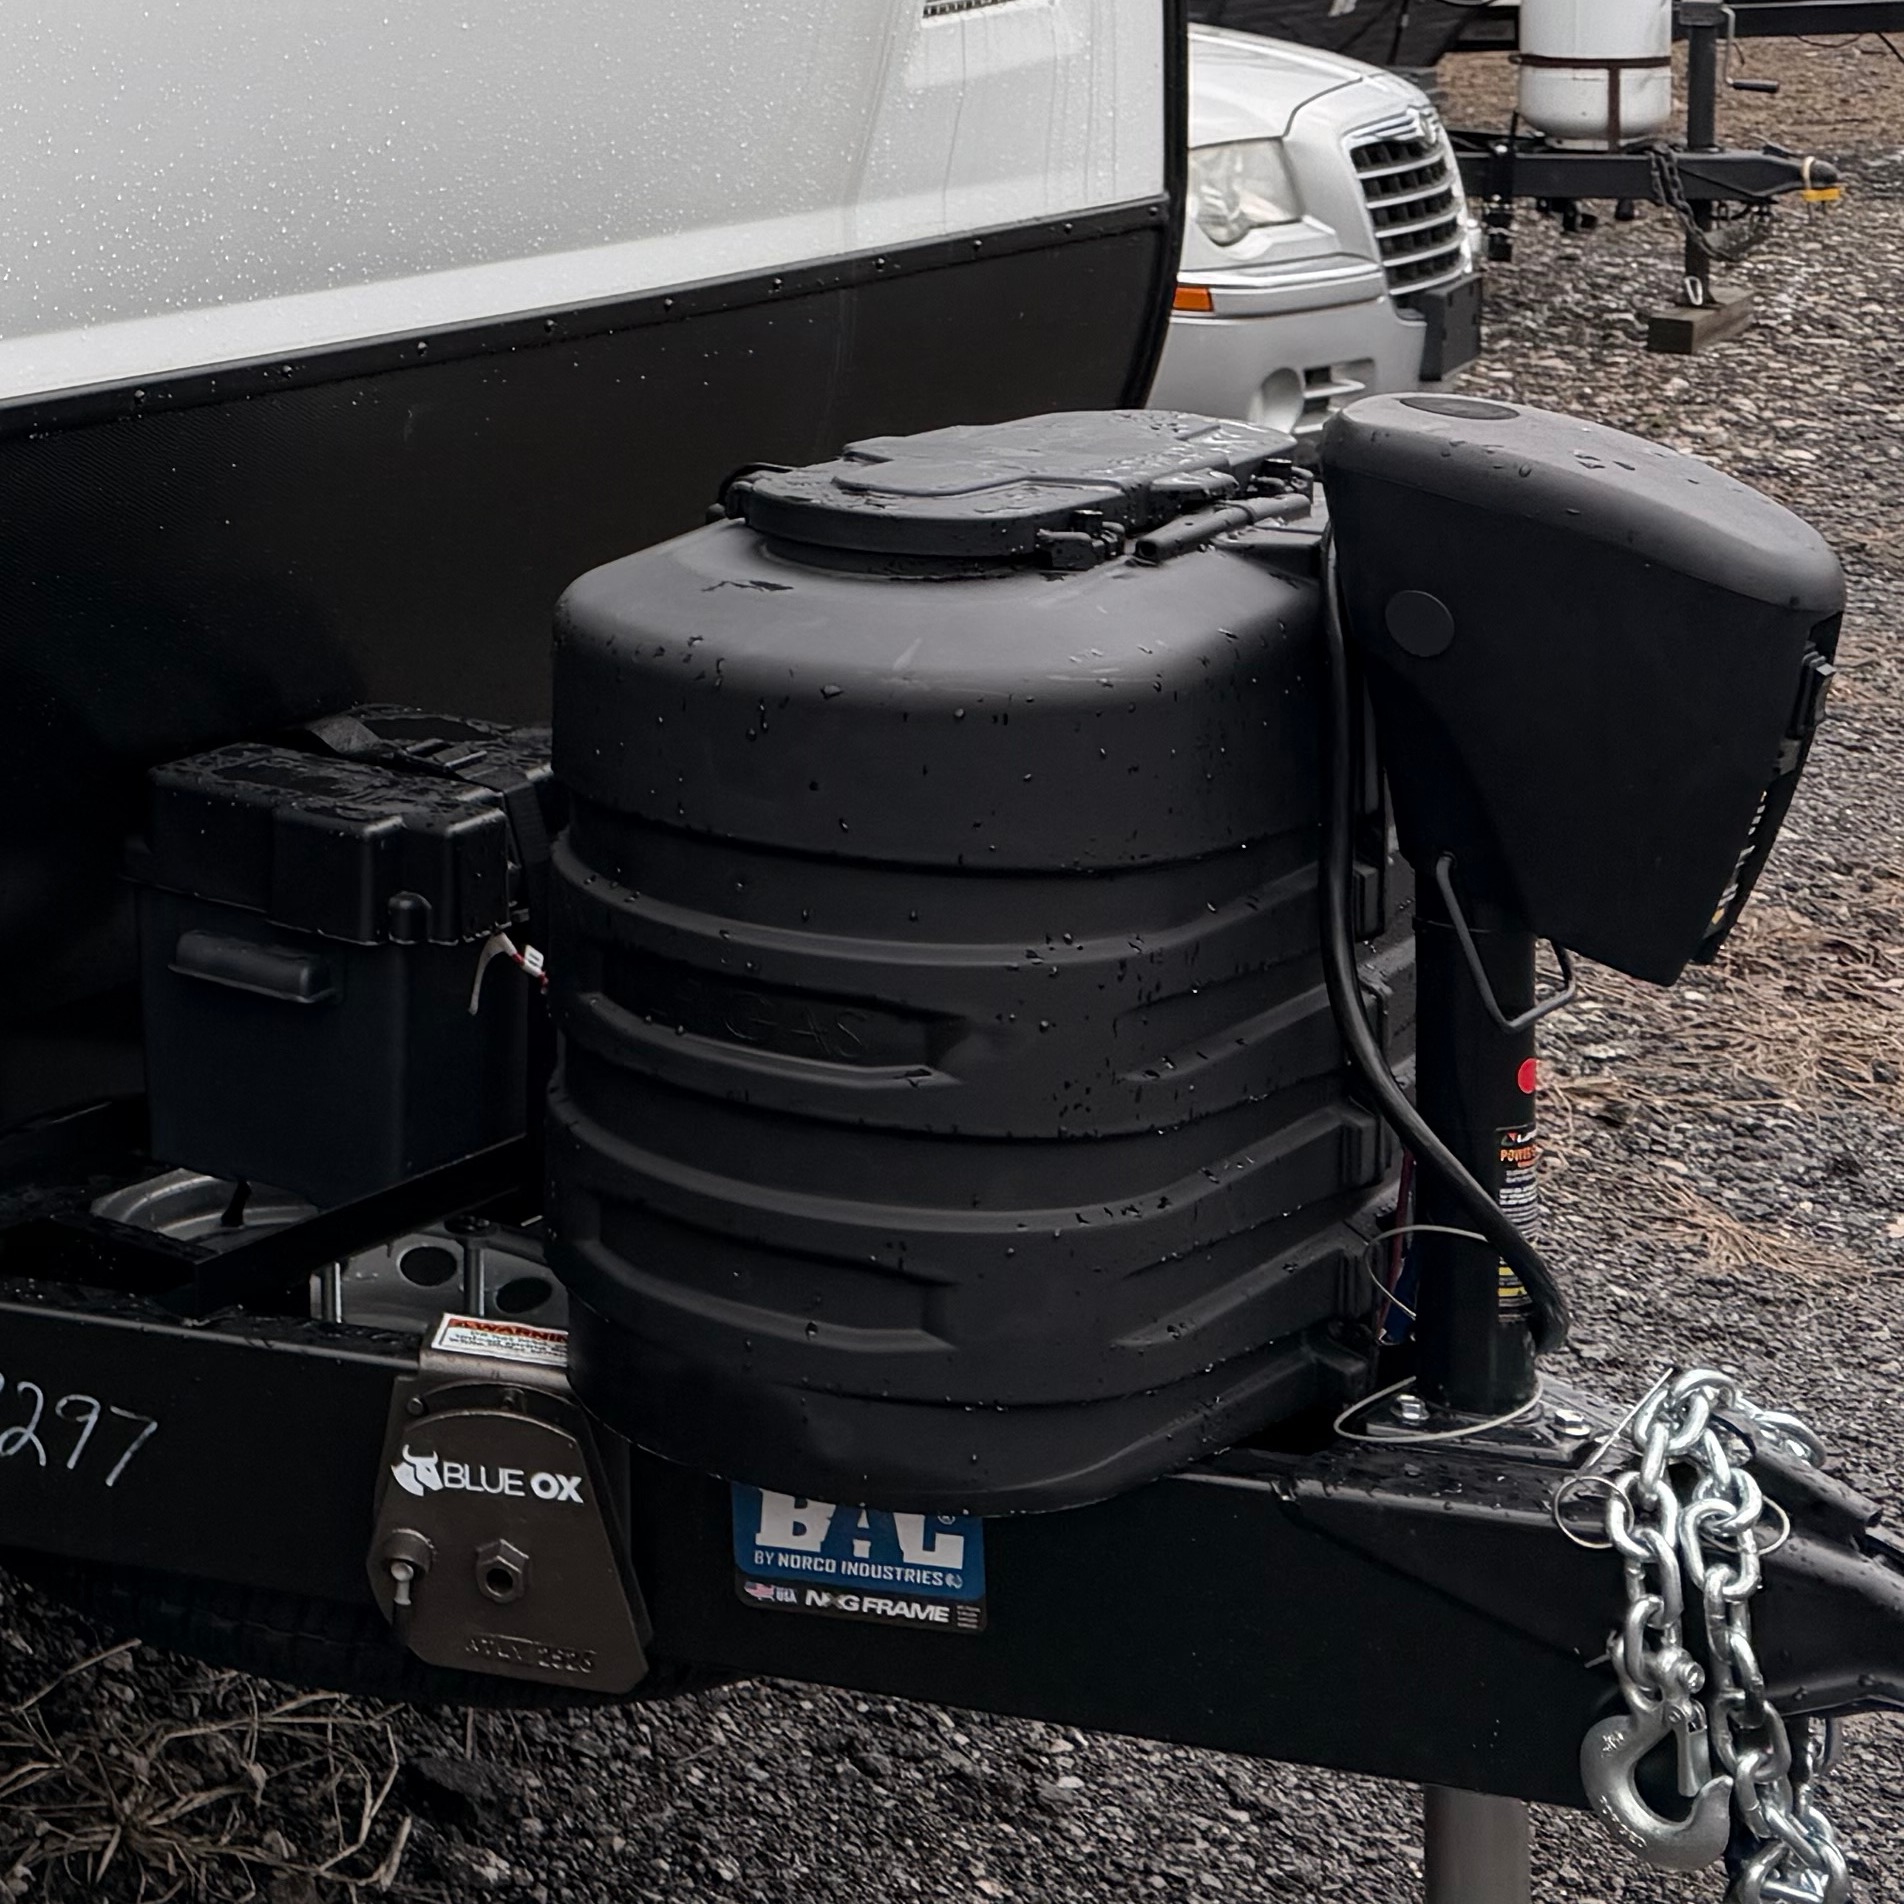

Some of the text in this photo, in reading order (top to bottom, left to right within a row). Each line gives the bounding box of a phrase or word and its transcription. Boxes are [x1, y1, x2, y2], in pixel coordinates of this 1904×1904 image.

[475, 1321, 568, 1343] WARNIN
[443, 1461, 584, 1504] BLUE OX
[754, 1549, 944, 1586] BY NORCO INDUSTRIES
[862, 1597, 950, 1623] FRAME
